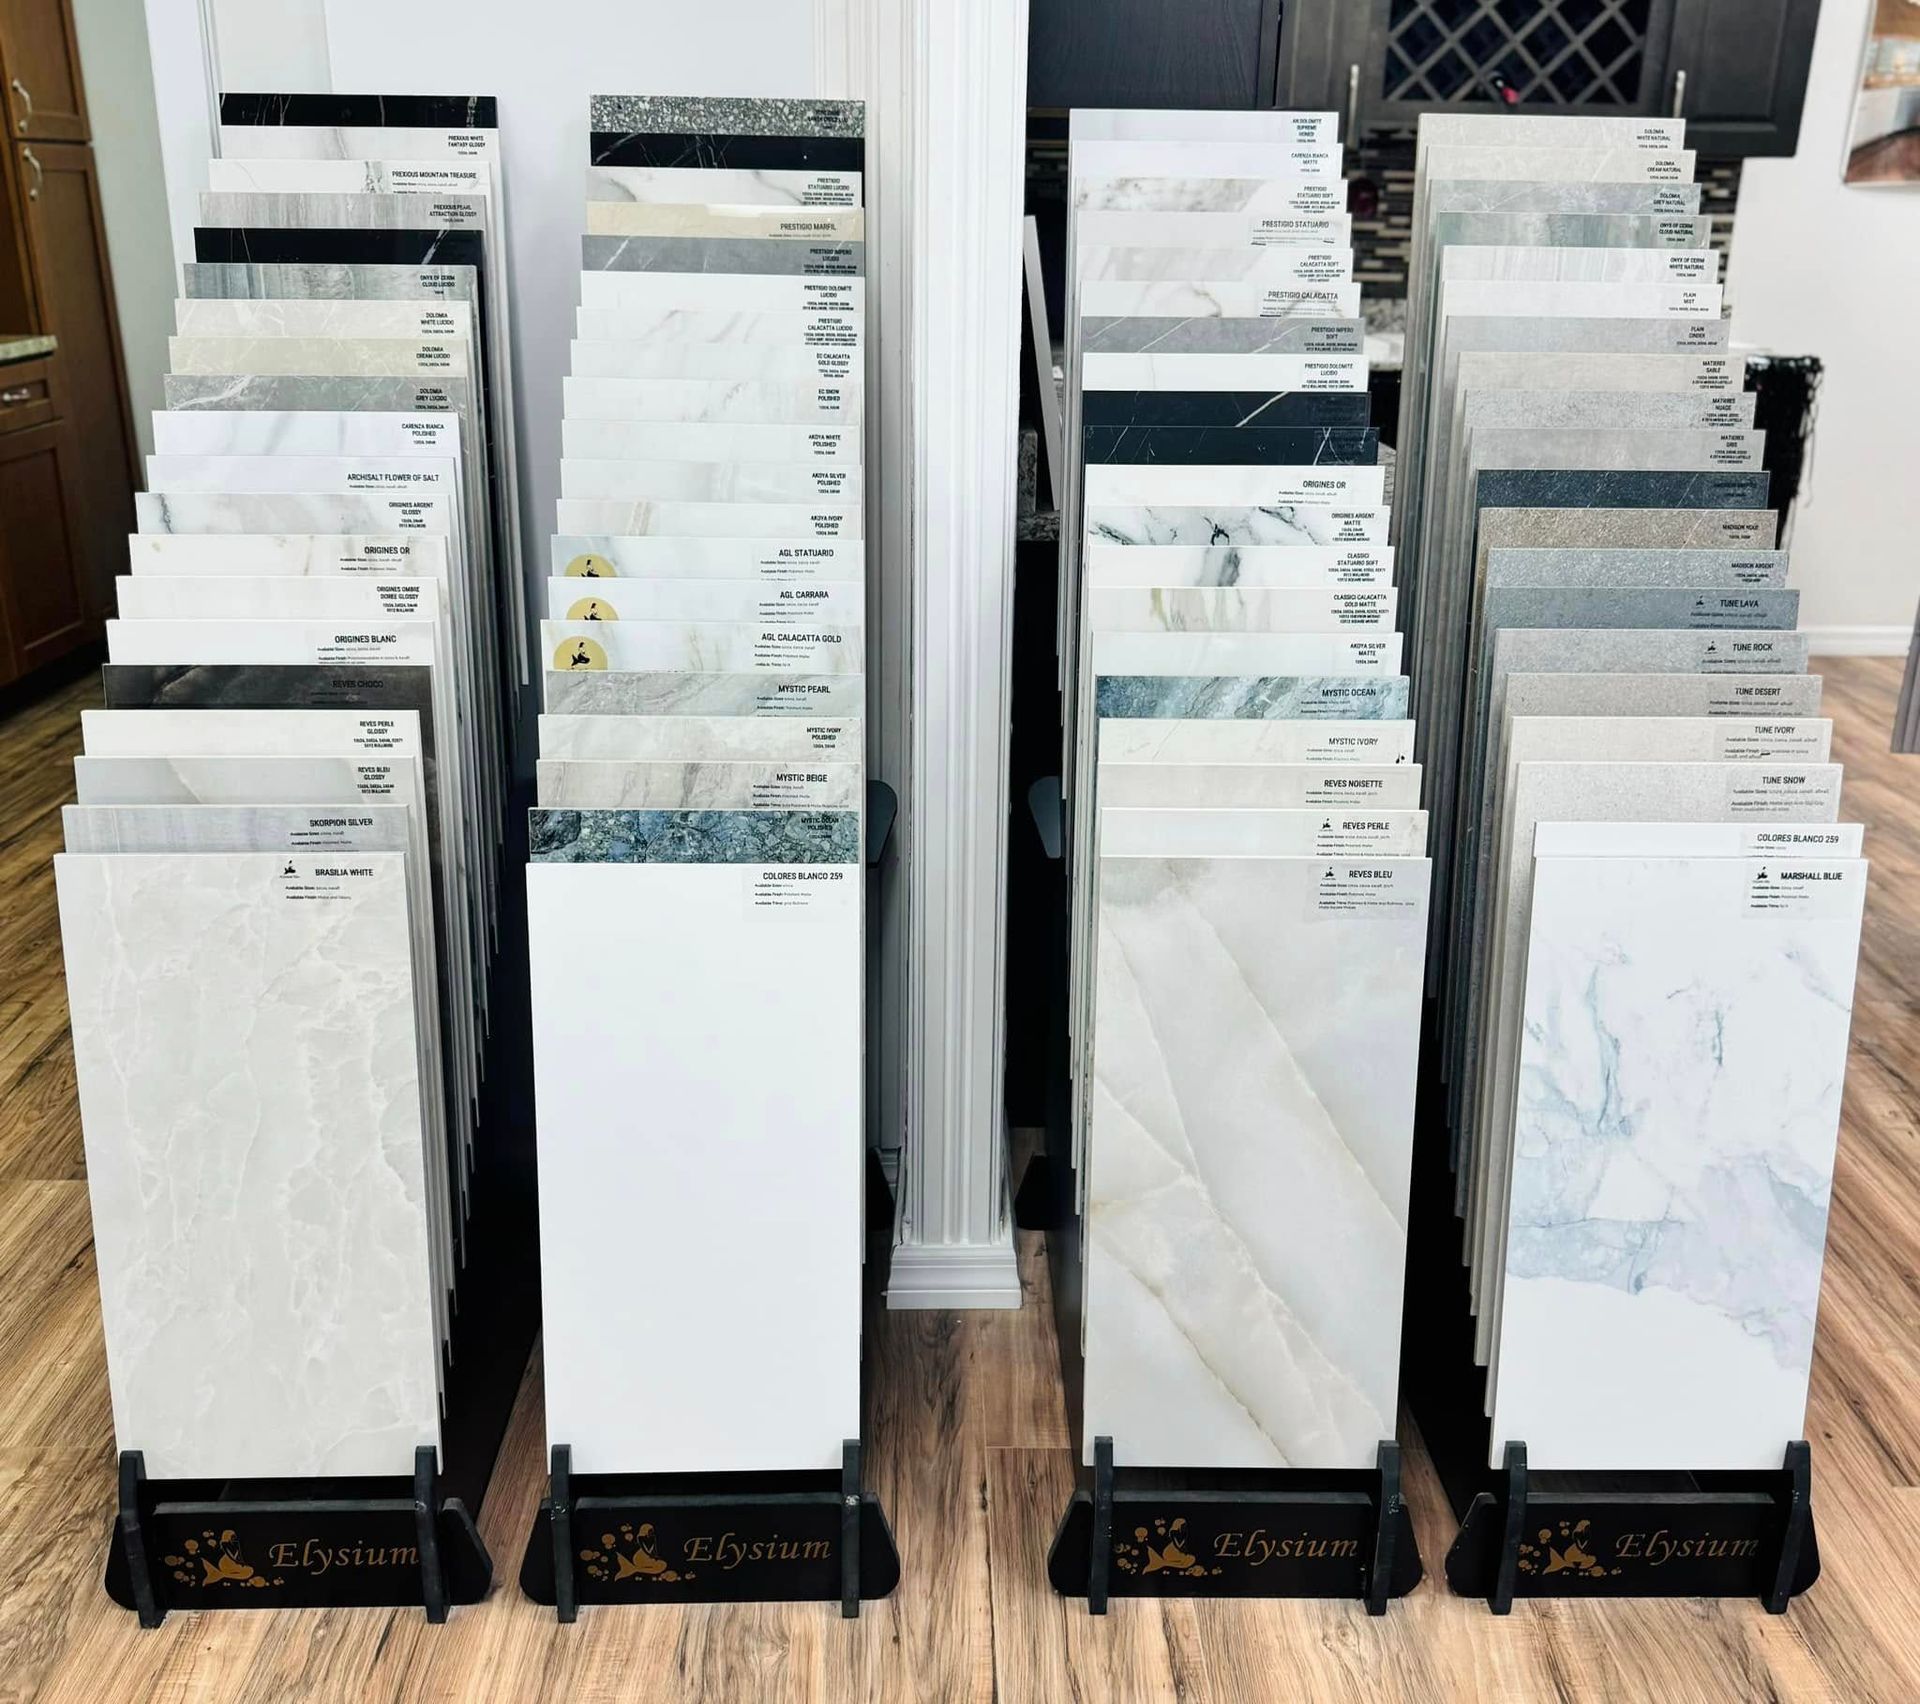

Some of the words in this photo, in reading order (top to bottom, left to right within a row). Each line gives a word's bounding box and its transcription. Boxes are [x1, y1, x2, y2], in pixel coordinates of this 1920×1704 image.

[813, 223, 836, 231] MARFIL
[1268, 291, 1300, 299] PRESTIGIO
[347, 473, 382, 481] ARCHISALT
[422, 474, 439, 482] SALT
[1303, 480, 1335, 488] ORIGINES
[1336, 481, 1346, 489] OR
[364, 546, 398, 555] ORIGINES
[400, 546, 410, 555] OR
[779, 549, 793, 557] AGL
[794, 549, 834, 557] STATUARIO
[780, 591, 794, 599] AGL
[796, 591, 829, 599] CARRARA
[1720, 600, 1739, 608] TUNE
[1740, 600, 1759, 608] LAVA
[335, 635, 369, 644] ORIGINES
[371, 635, 397, 643] BLANC
[761, 633, 775, 641] AGL
[777, 634, 821, 642] CALACATTA
[822, 635, 842, 643] GOLD
[1733, 643, 1752, 651] TUNE
[1753, 643, 1773, 651] ROCK
[332, 680, 356, 688] REVES
[357, 680, 384, 688] CHOCO
[778, 685, 806, 693] MYSTIC
[808, 685, 831, 694] PEARL
[1322, 689, 1350, 697] MYSTIC
[1351, 688, 1376, 696] OCEAN
[1755, 688, 1781, 696] DESERT
[1754, 726, 1772, 734] TUNE
[1774, 726, 1795, 734] IVORY
[776, 774, 805, 782] MYSTIC
[806, 774, 828, 782] BEIGE
[1762, 776, 1782, 784] TUNE
[1783, 776, 1806, 784] SNOW
[1324, 780, 1347, 788] REVES
[1348, 780, 1383, 788] NOISETTE
[309, 819, 346, 827] SKORPION
[348, 818, 373, 826] SILVER
[1343, 822, 1365, 830] REVES
[1367, 822, 1390, 830] PERLE
[1757, 833, 1792, 842] COLORES
[1793, 834, 1823, 843] BLANCO
[1825, 835, 1839, 844] 259
[315, 868, 348, 876] BRASILIA
[350, 868, 374, 876] WHITE
[763, 872, 797, 880] COLORES
[798, 872, 828, 880] BLANCO
[830, 872, 843, 880] 259
[1349, 870, 1372, 878] REVES
[1781, 872, 1822, 880] MARSHALL
[1823, 872, 1843, 880] BLUE
[684, 1532, 830, 1570] Elysium
[1214, 1530, 1358, 1566] Elysium
[1616, 1530, 1759, 1566] Elysium
[269, 1538, 419, 1575] Elysium
